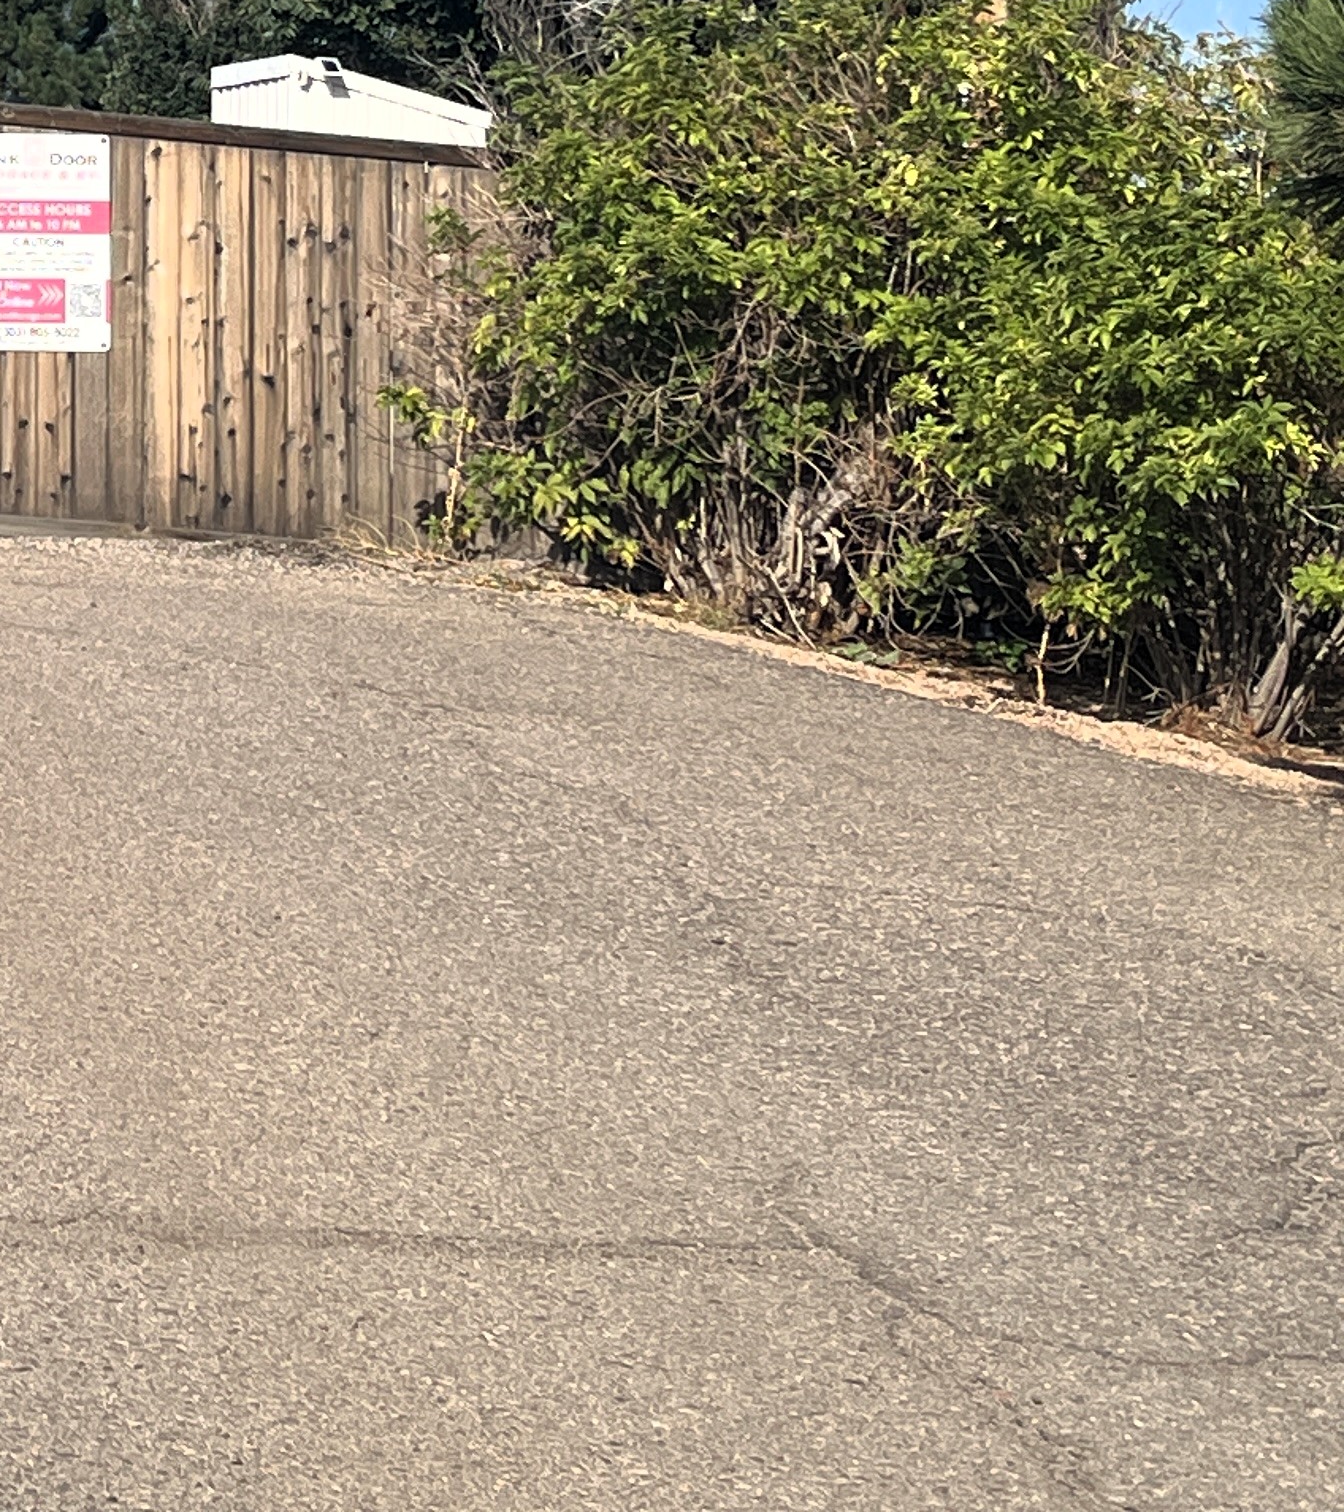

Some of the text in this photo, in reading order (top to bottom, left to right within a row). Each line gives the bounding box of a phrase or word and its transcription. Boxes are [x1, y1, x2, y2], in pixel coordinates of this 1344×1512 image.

[49, 152, 98, 166] DOOR
[44, 203, 92, 217] HOURS
[6, 219, 28, 231] AM
[62, 220, 82, 232] PM
